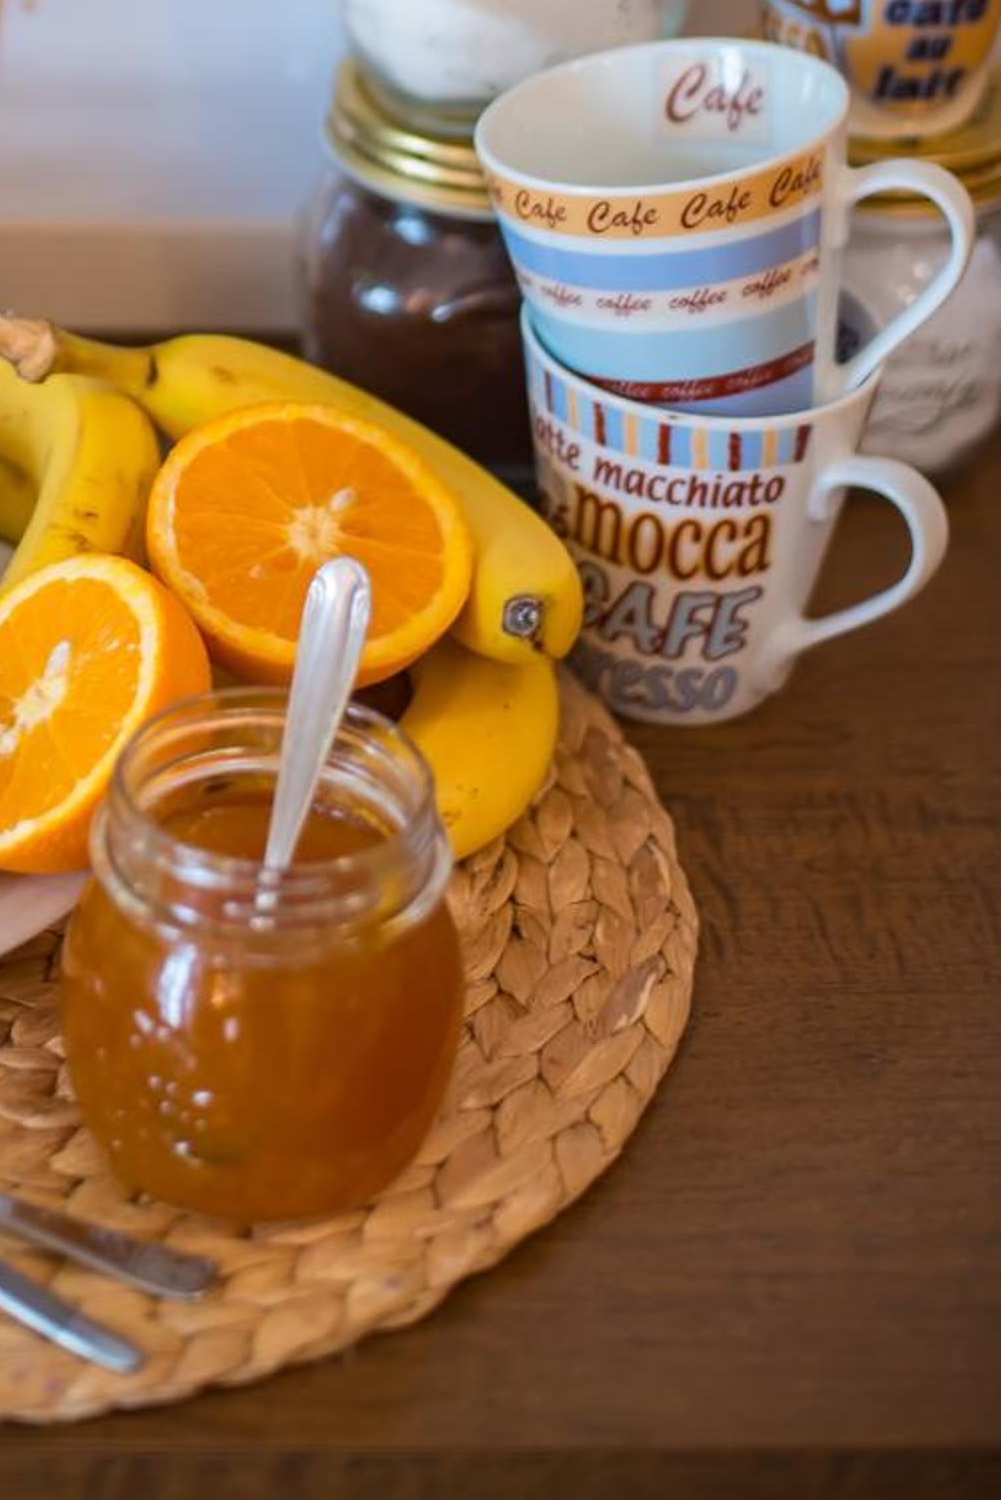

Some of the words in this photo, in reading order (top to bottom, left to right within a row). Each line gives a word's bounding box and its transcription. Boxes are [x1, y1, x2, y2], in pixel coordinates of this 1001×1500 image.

[906, 36, 952, 61] au
[665, 63, 764, 131] Cafe
[514, 189, 568, 227] Cafe
[586, 201, 660, 235] Cafe
[680, 181, 751, 228] Cafe
[598, 293, 652, 317] coffee
[668, 288, 728, 313] coffee
[741, 270, 793, 301] coffee
[593, 455, 785, 509] macchiato
[574, 484, 770, 580] mocca
